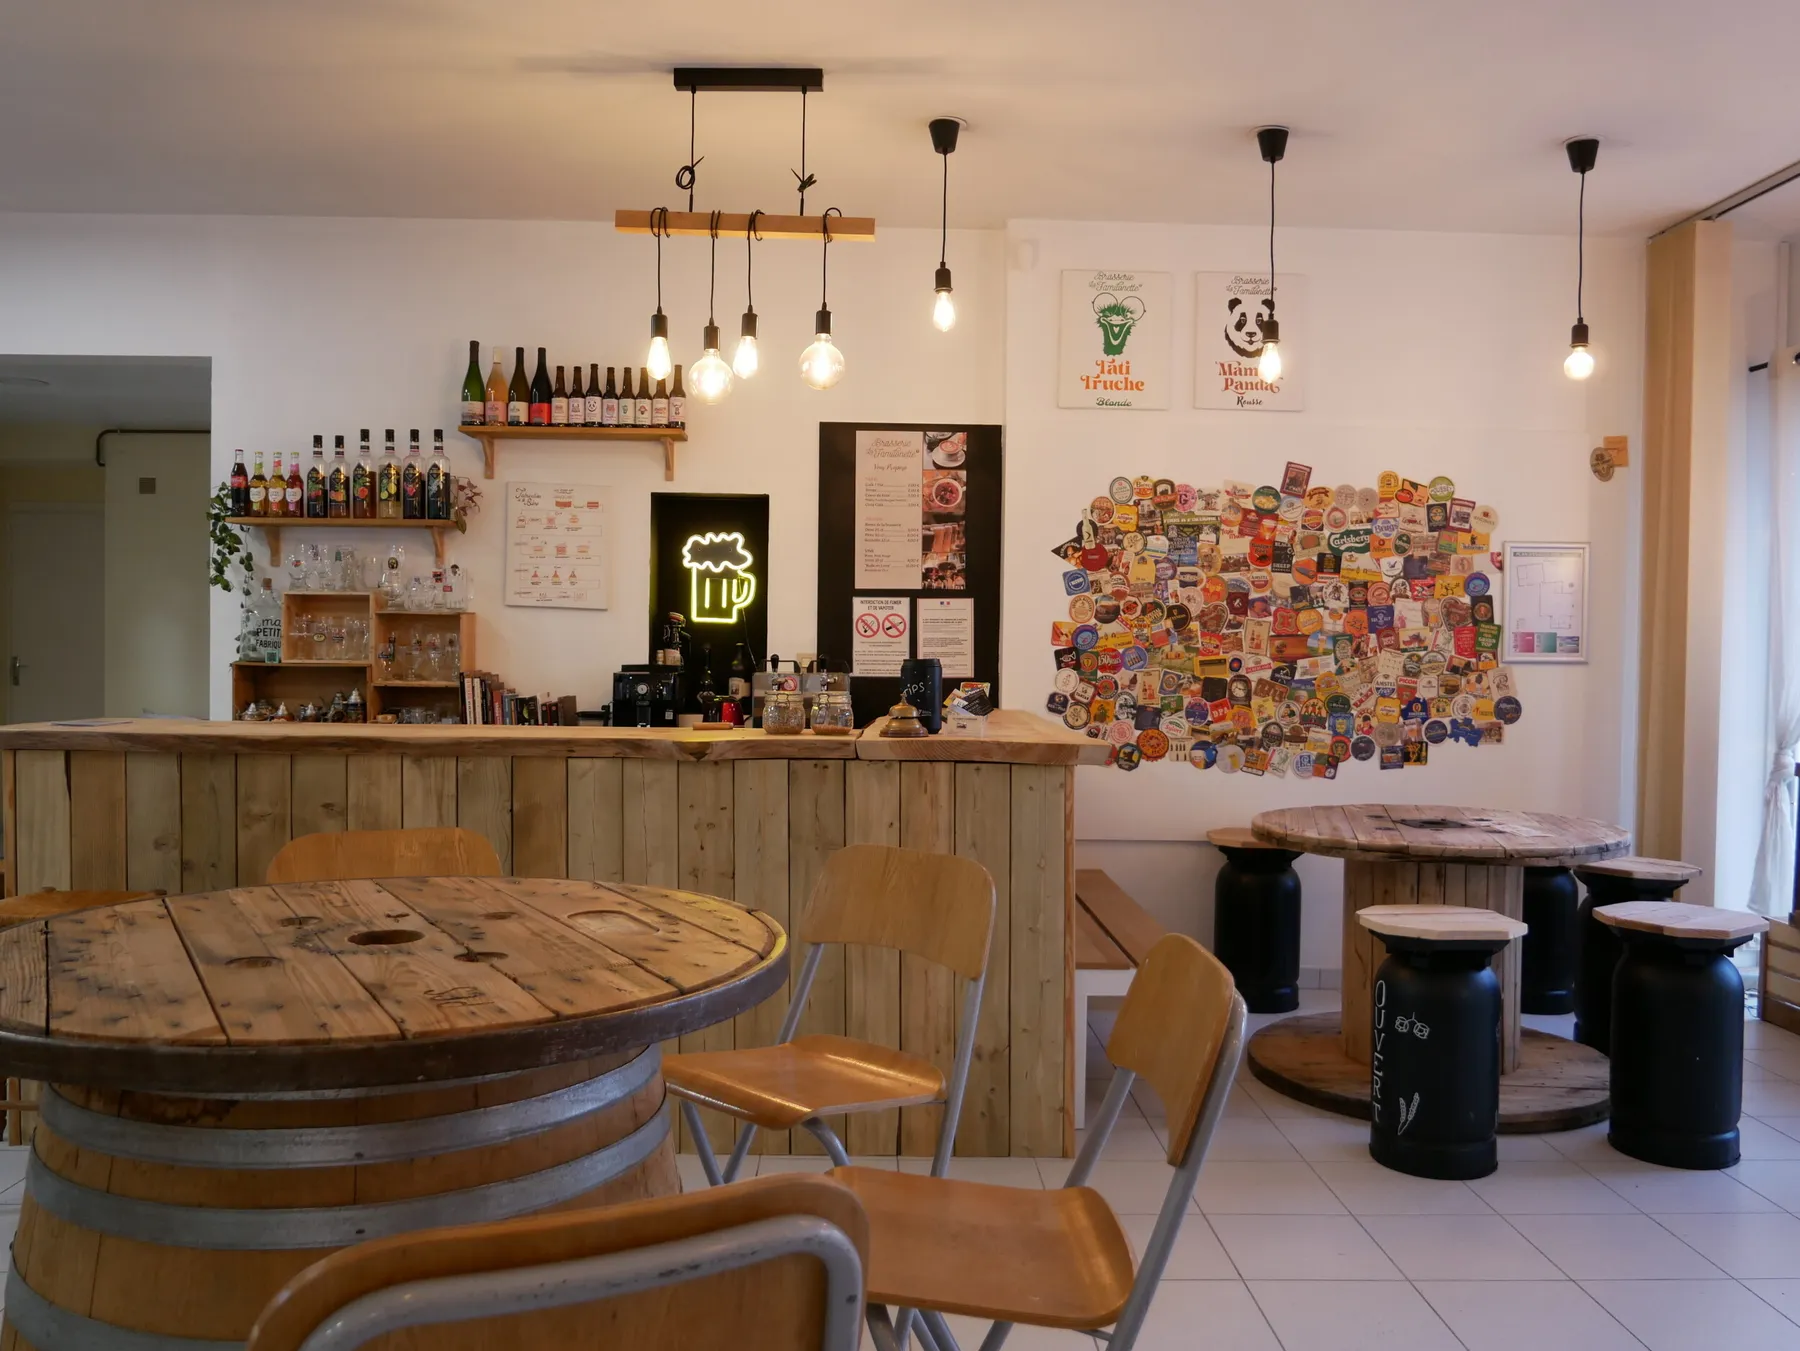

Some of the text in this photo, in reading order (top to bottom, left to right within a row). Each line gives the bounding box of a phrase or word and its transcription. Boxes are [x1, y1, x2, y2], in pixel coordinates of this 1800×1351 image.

[1230, 275, 1270, 285] Brasserie
[1095, 396, 1133, 407] Blonde
[1236, 395, 1263, 408] Rousse
[1330, 533, 1371, 549] Carlsberg
[256, 628, 282, 638] PETIT
[1373, 979, 1387, 1123] OUVERT
